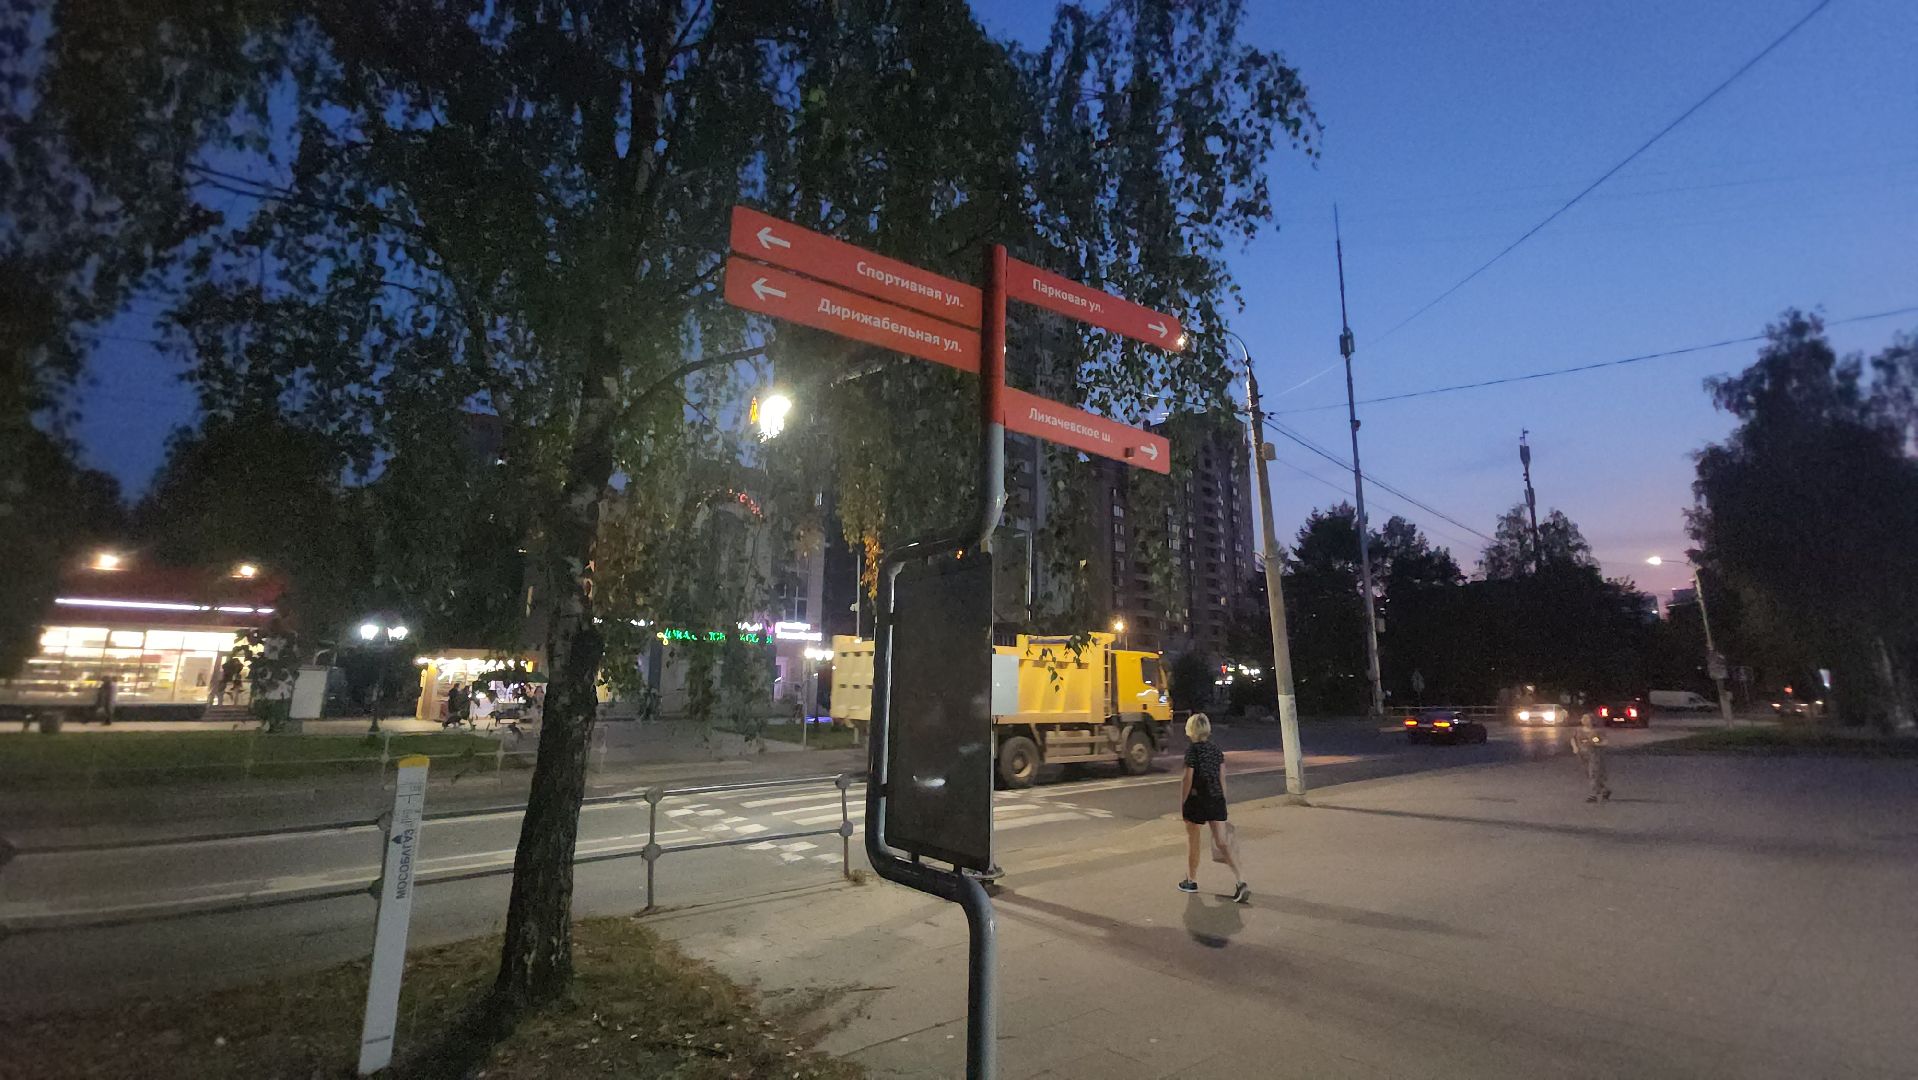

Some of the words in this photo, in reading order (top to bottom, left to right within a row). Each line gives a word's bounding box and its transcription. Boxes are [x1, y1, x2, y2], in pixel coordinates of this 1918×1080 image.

[856, 261, 942, 300] Спортивная
[945, 292, 965, 308] ул.
[1032, 278, 1087, 307] Парковая
[1088, 300, 1105, 314] ул.
[817, 298, 940, 345] Дирижабельная
[943, 338, 963, 353] ул.
[1029, 407, 1100, 439] Лихачевское
[1101, 433, 1114, 444] ш.
[395, 828, 415, 900] МОСОБЛГАЗ
